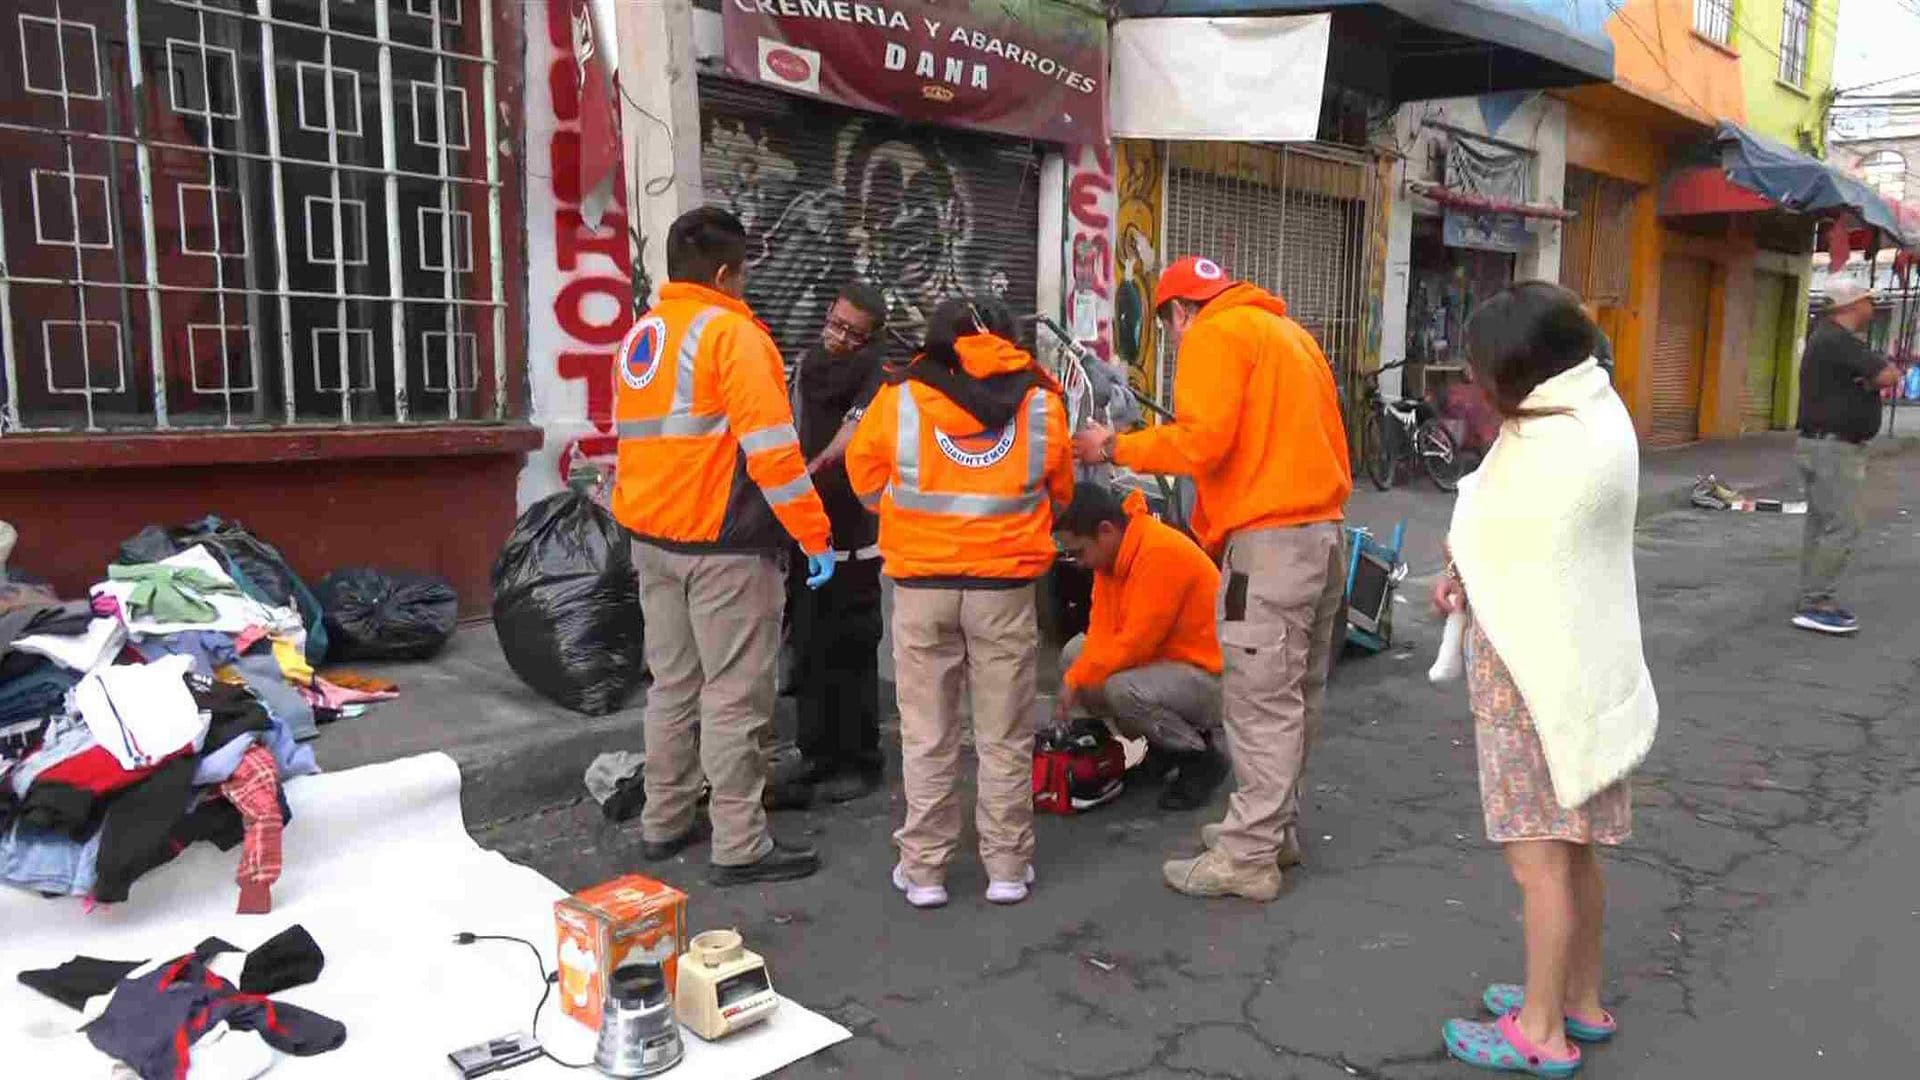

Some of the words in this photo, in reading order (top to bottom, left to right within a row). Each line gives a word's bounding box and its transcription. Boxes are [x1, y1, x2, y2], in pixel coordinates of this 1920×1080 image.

[884, 41, 989, 91] DANA
[923, 17, 942, 38] Y
[950, 26, 1098, 94] ABARROTES
